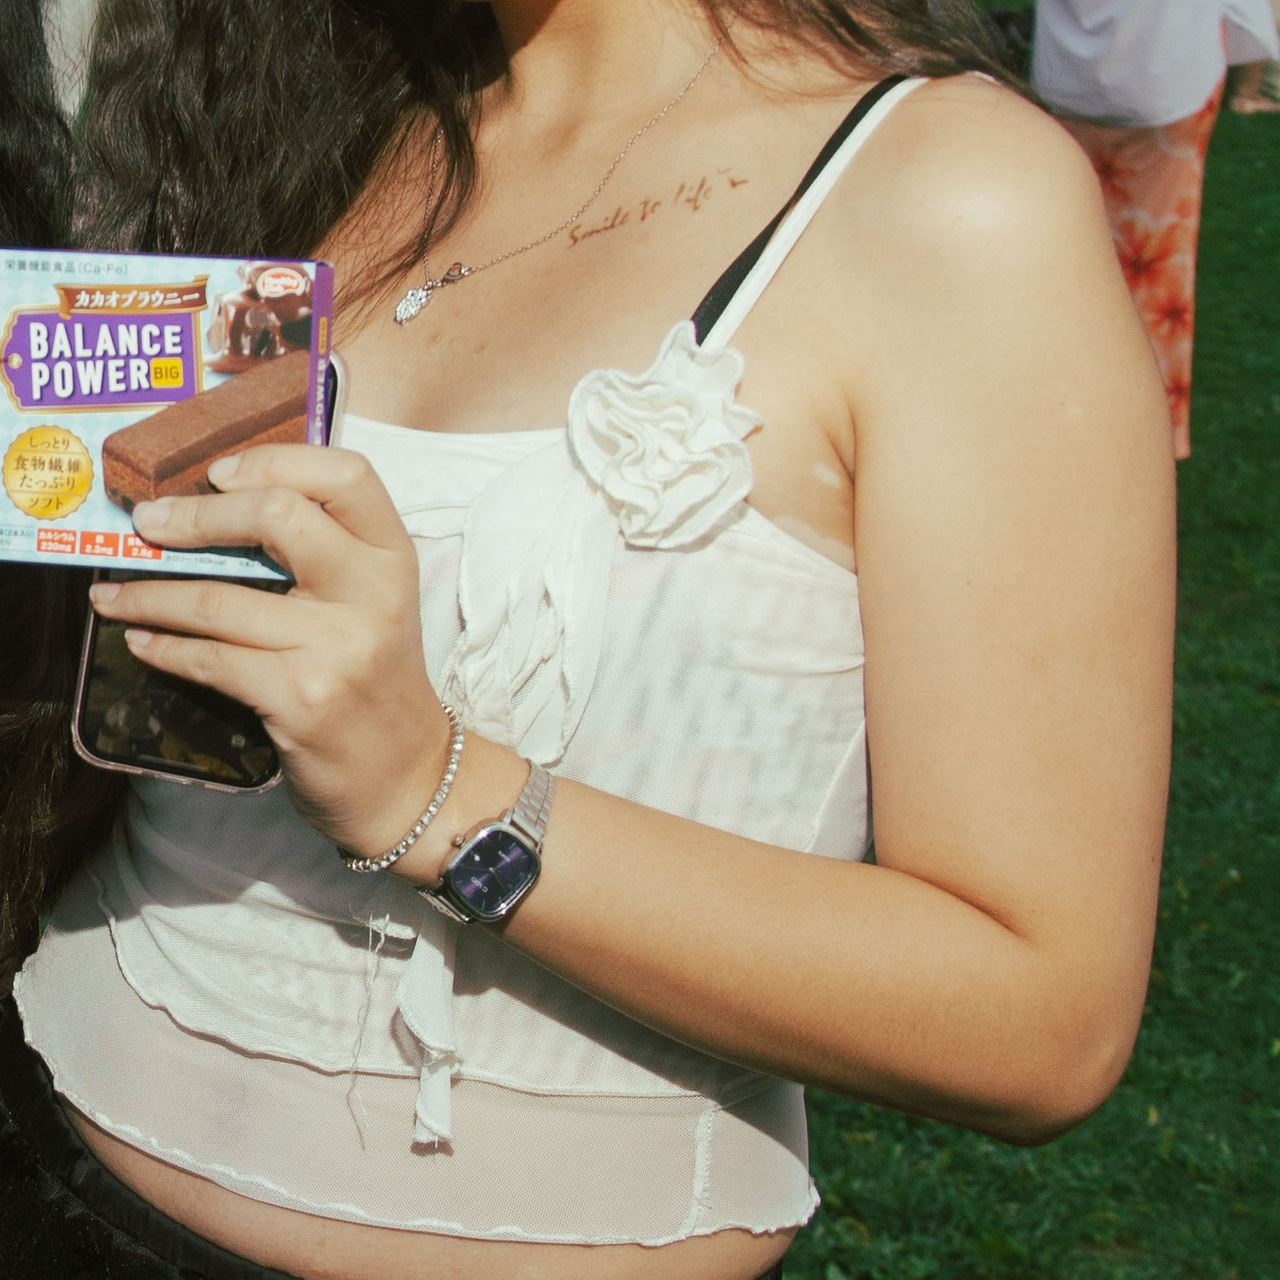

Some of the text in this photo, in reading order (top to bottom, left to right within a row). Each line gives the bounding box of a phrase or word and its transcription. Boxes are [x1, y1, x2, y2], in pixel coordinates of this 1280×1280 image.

[74, 289, 200, 310] カカオブラウニー
[29, 321, 183, 360] BALANCE
[31, 358, 180, 401] POWER BIG
[29, 435, 71, 450] しっとり
[14, 454, 81, 474] 食物繊維
[19, 473, 76, 491] たっぷり
[28, 496, 64, 510] ソフト
